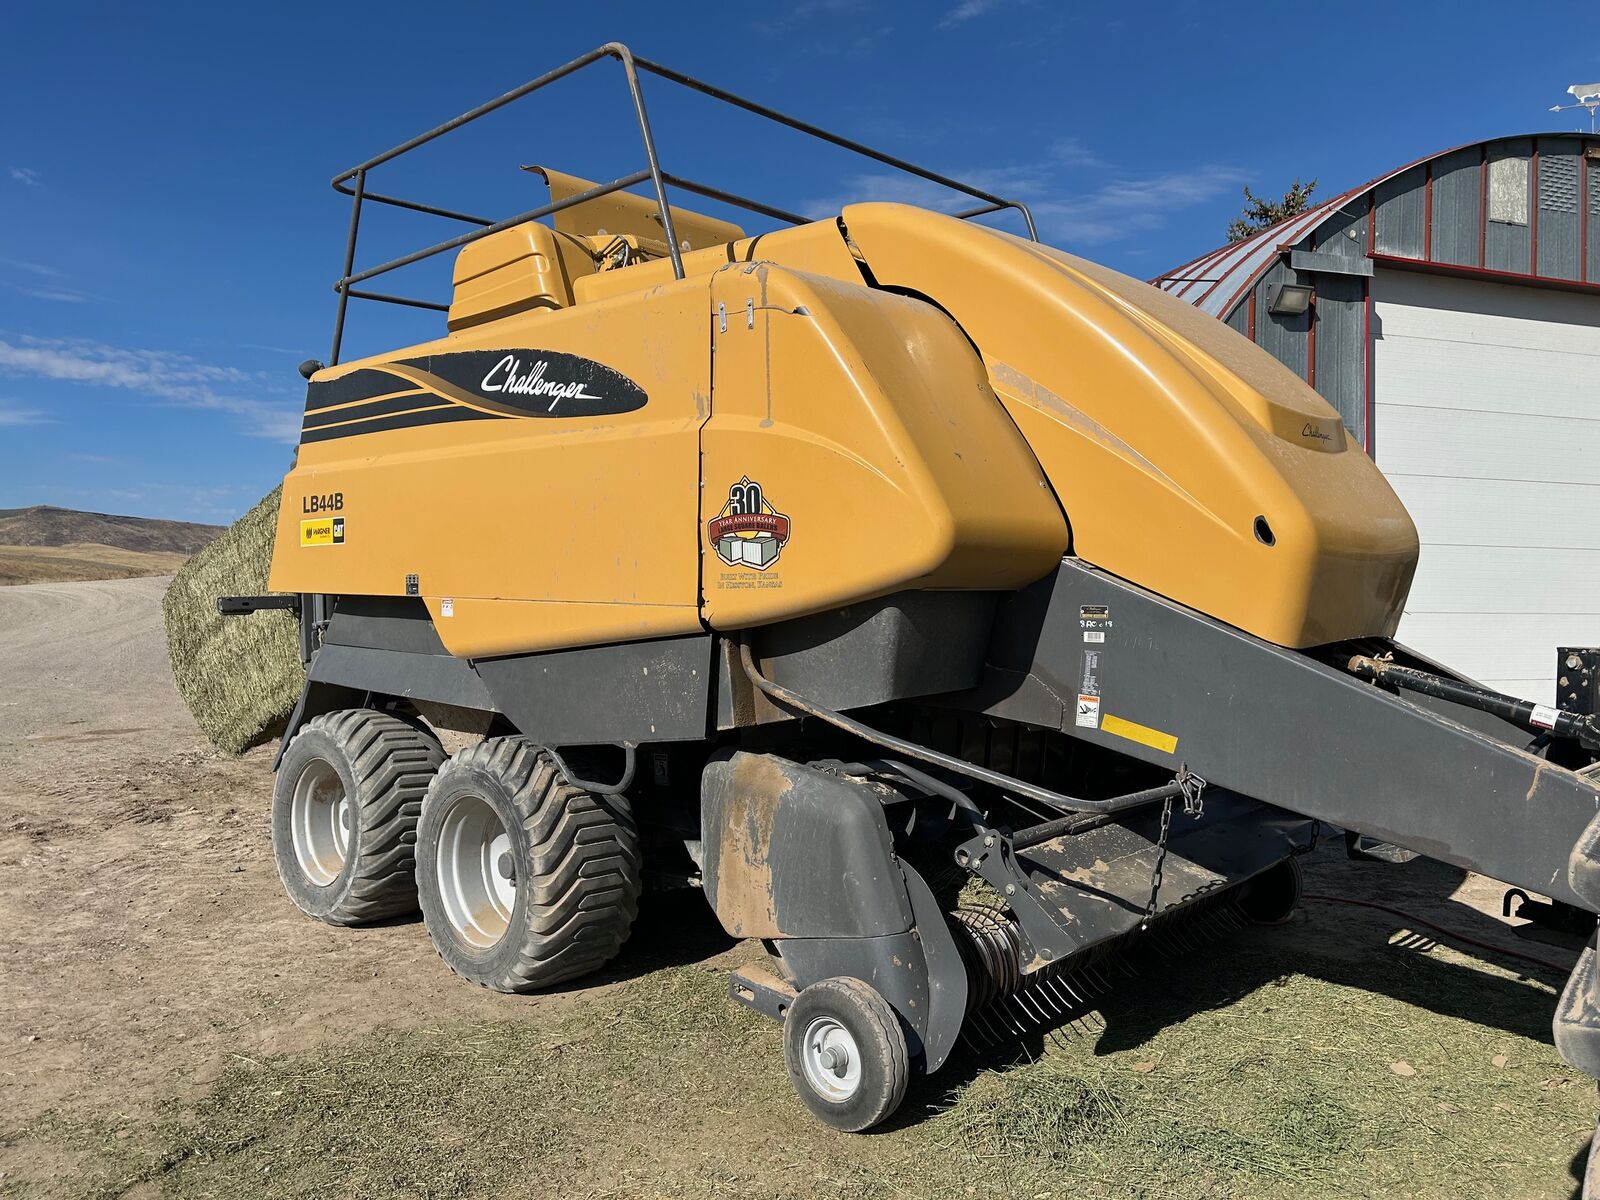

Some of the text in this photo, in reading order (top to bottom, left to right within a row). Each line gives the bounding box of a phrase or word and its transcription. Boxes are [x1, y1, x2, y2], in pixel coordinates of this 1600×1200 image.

[481, 354, 603, 412] Challenger
[303, 492, 344, 513] LB44B
[731, 486, 760, 515] 30
[334, 524, 344, 537] CAT
[718, 516, 777, 527] YEAR ANNIVERSARY
